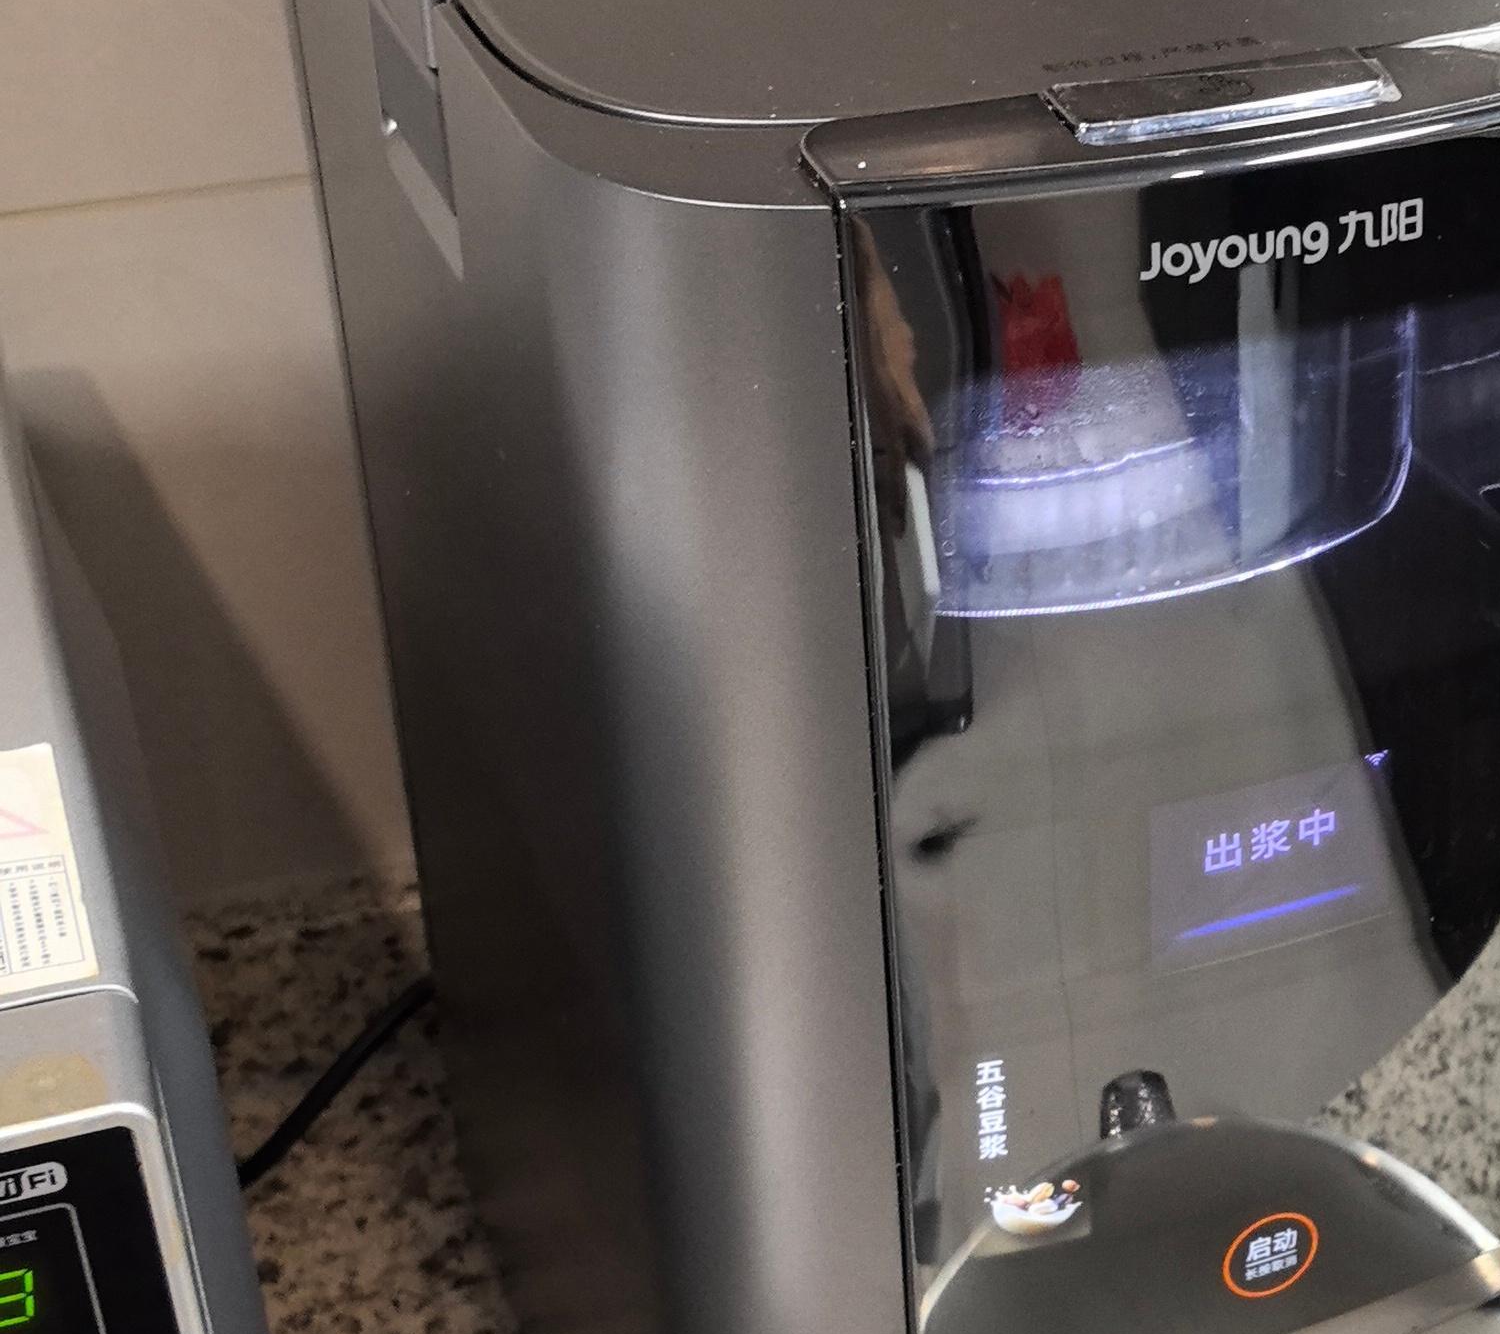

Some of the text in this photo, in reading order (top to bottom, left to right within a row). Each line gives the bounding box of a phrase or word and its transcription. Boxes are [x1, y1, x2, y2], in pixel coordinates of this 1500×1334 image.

[1140, 197, 1424, 284] Joyoung 九阳
[1204, 808, 1336, 873] 出浆中
[976, 1059, 1009, 1160] 五谷豆浆
[1246, 1227, 1298, 1262] 启动
